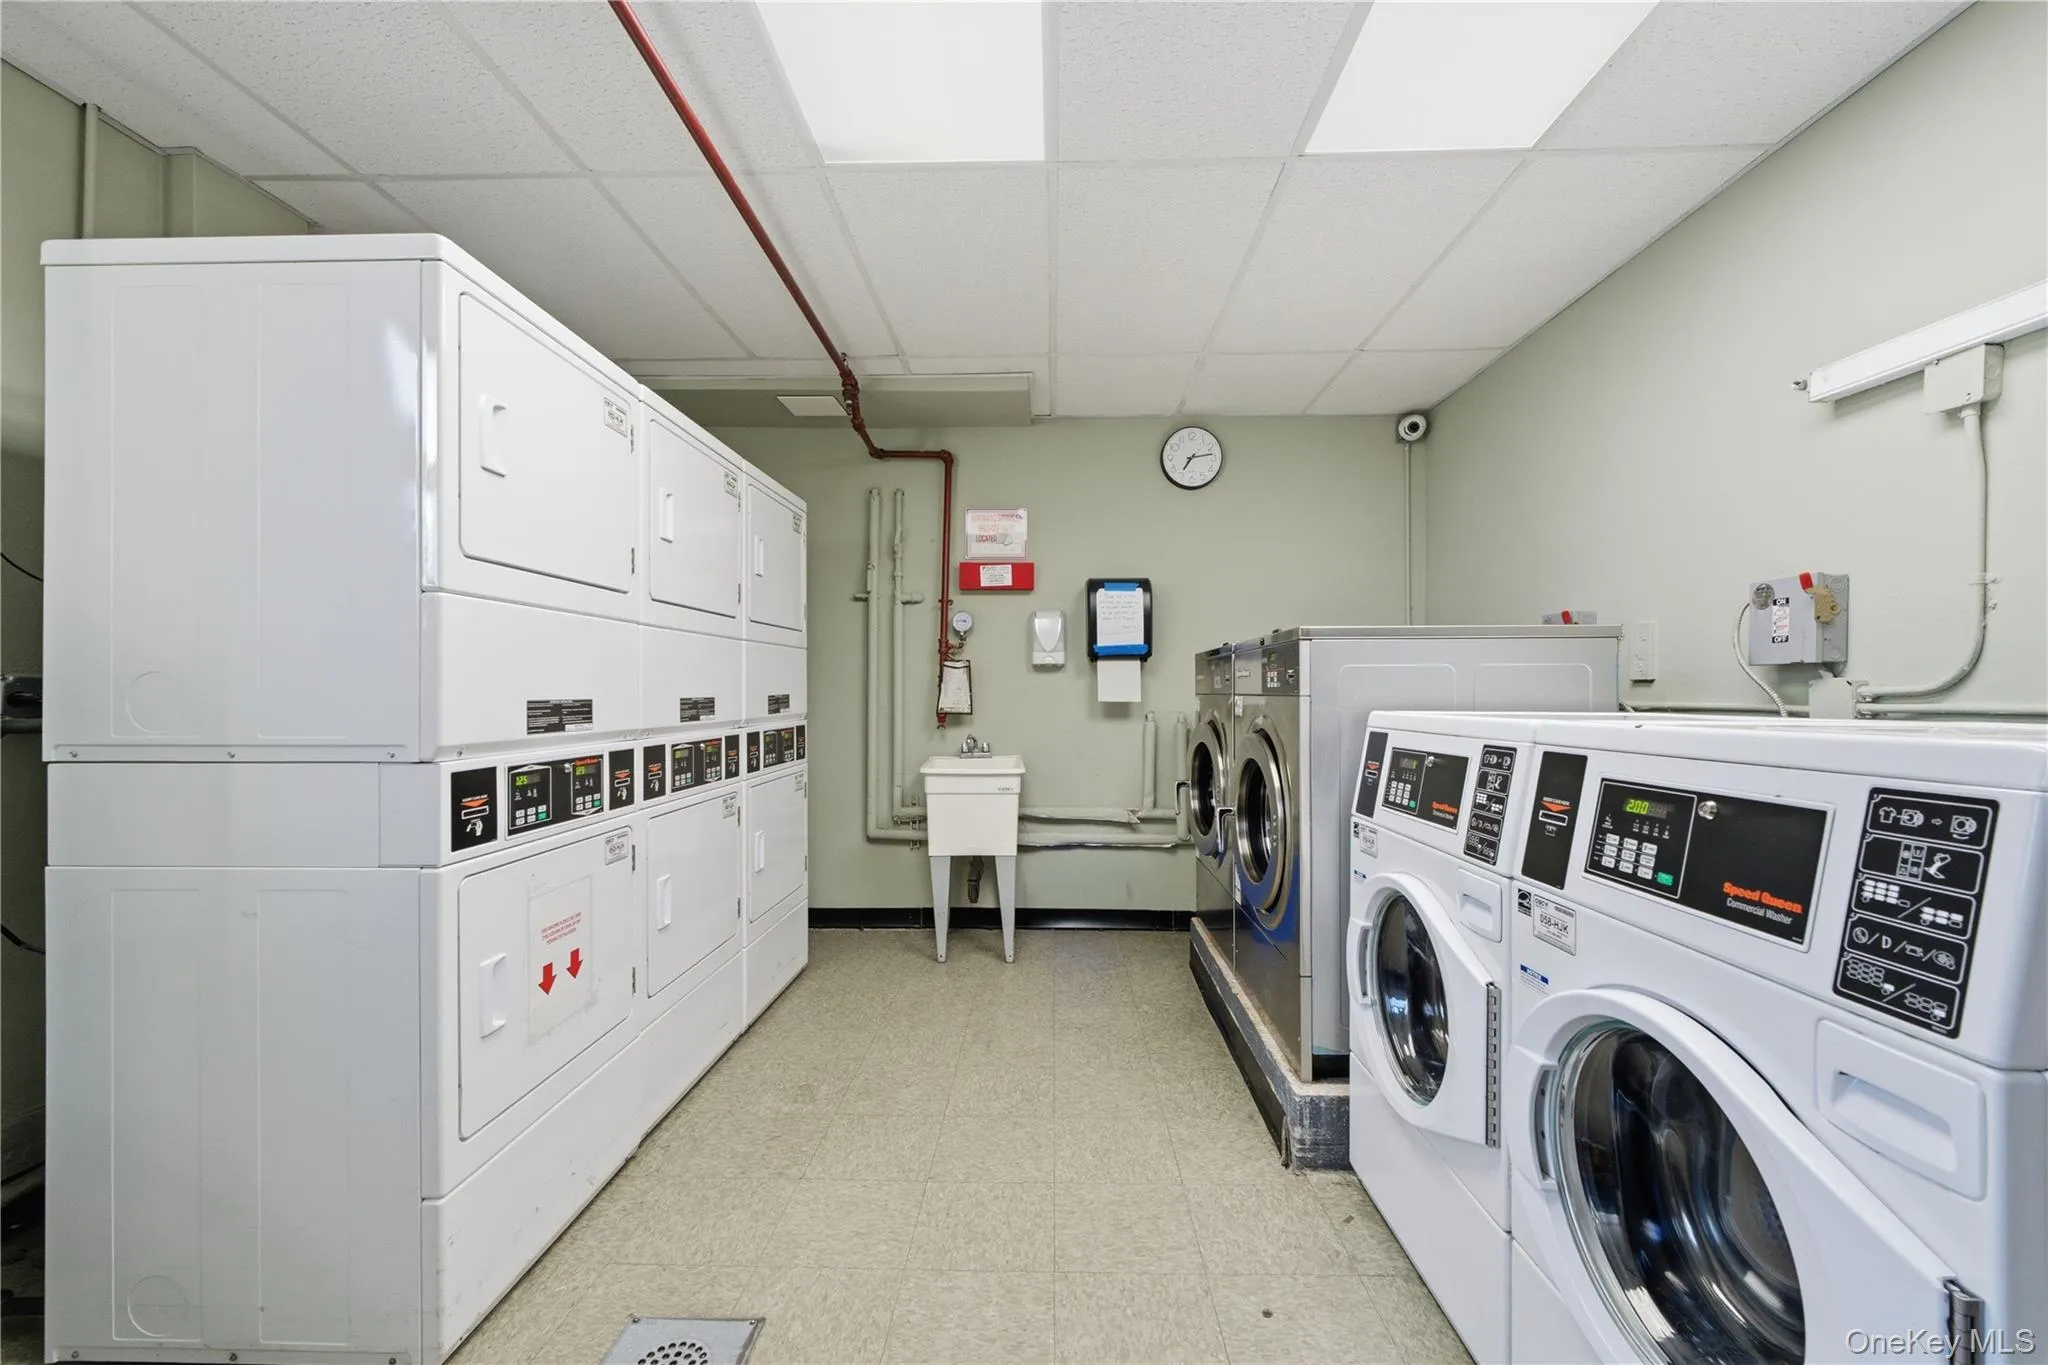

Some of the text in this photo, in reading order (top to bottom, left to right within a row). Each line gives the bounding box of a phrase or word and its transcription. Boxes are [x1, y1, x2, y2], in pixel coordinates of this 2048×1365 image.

[976, 534, 997, 543] LOCATED
[1774, 635, 1788, 643] OFF
[1722, 881, 1803, 913] Speed Queen
[1726, 897, 1793, 925] Commercial Washer
